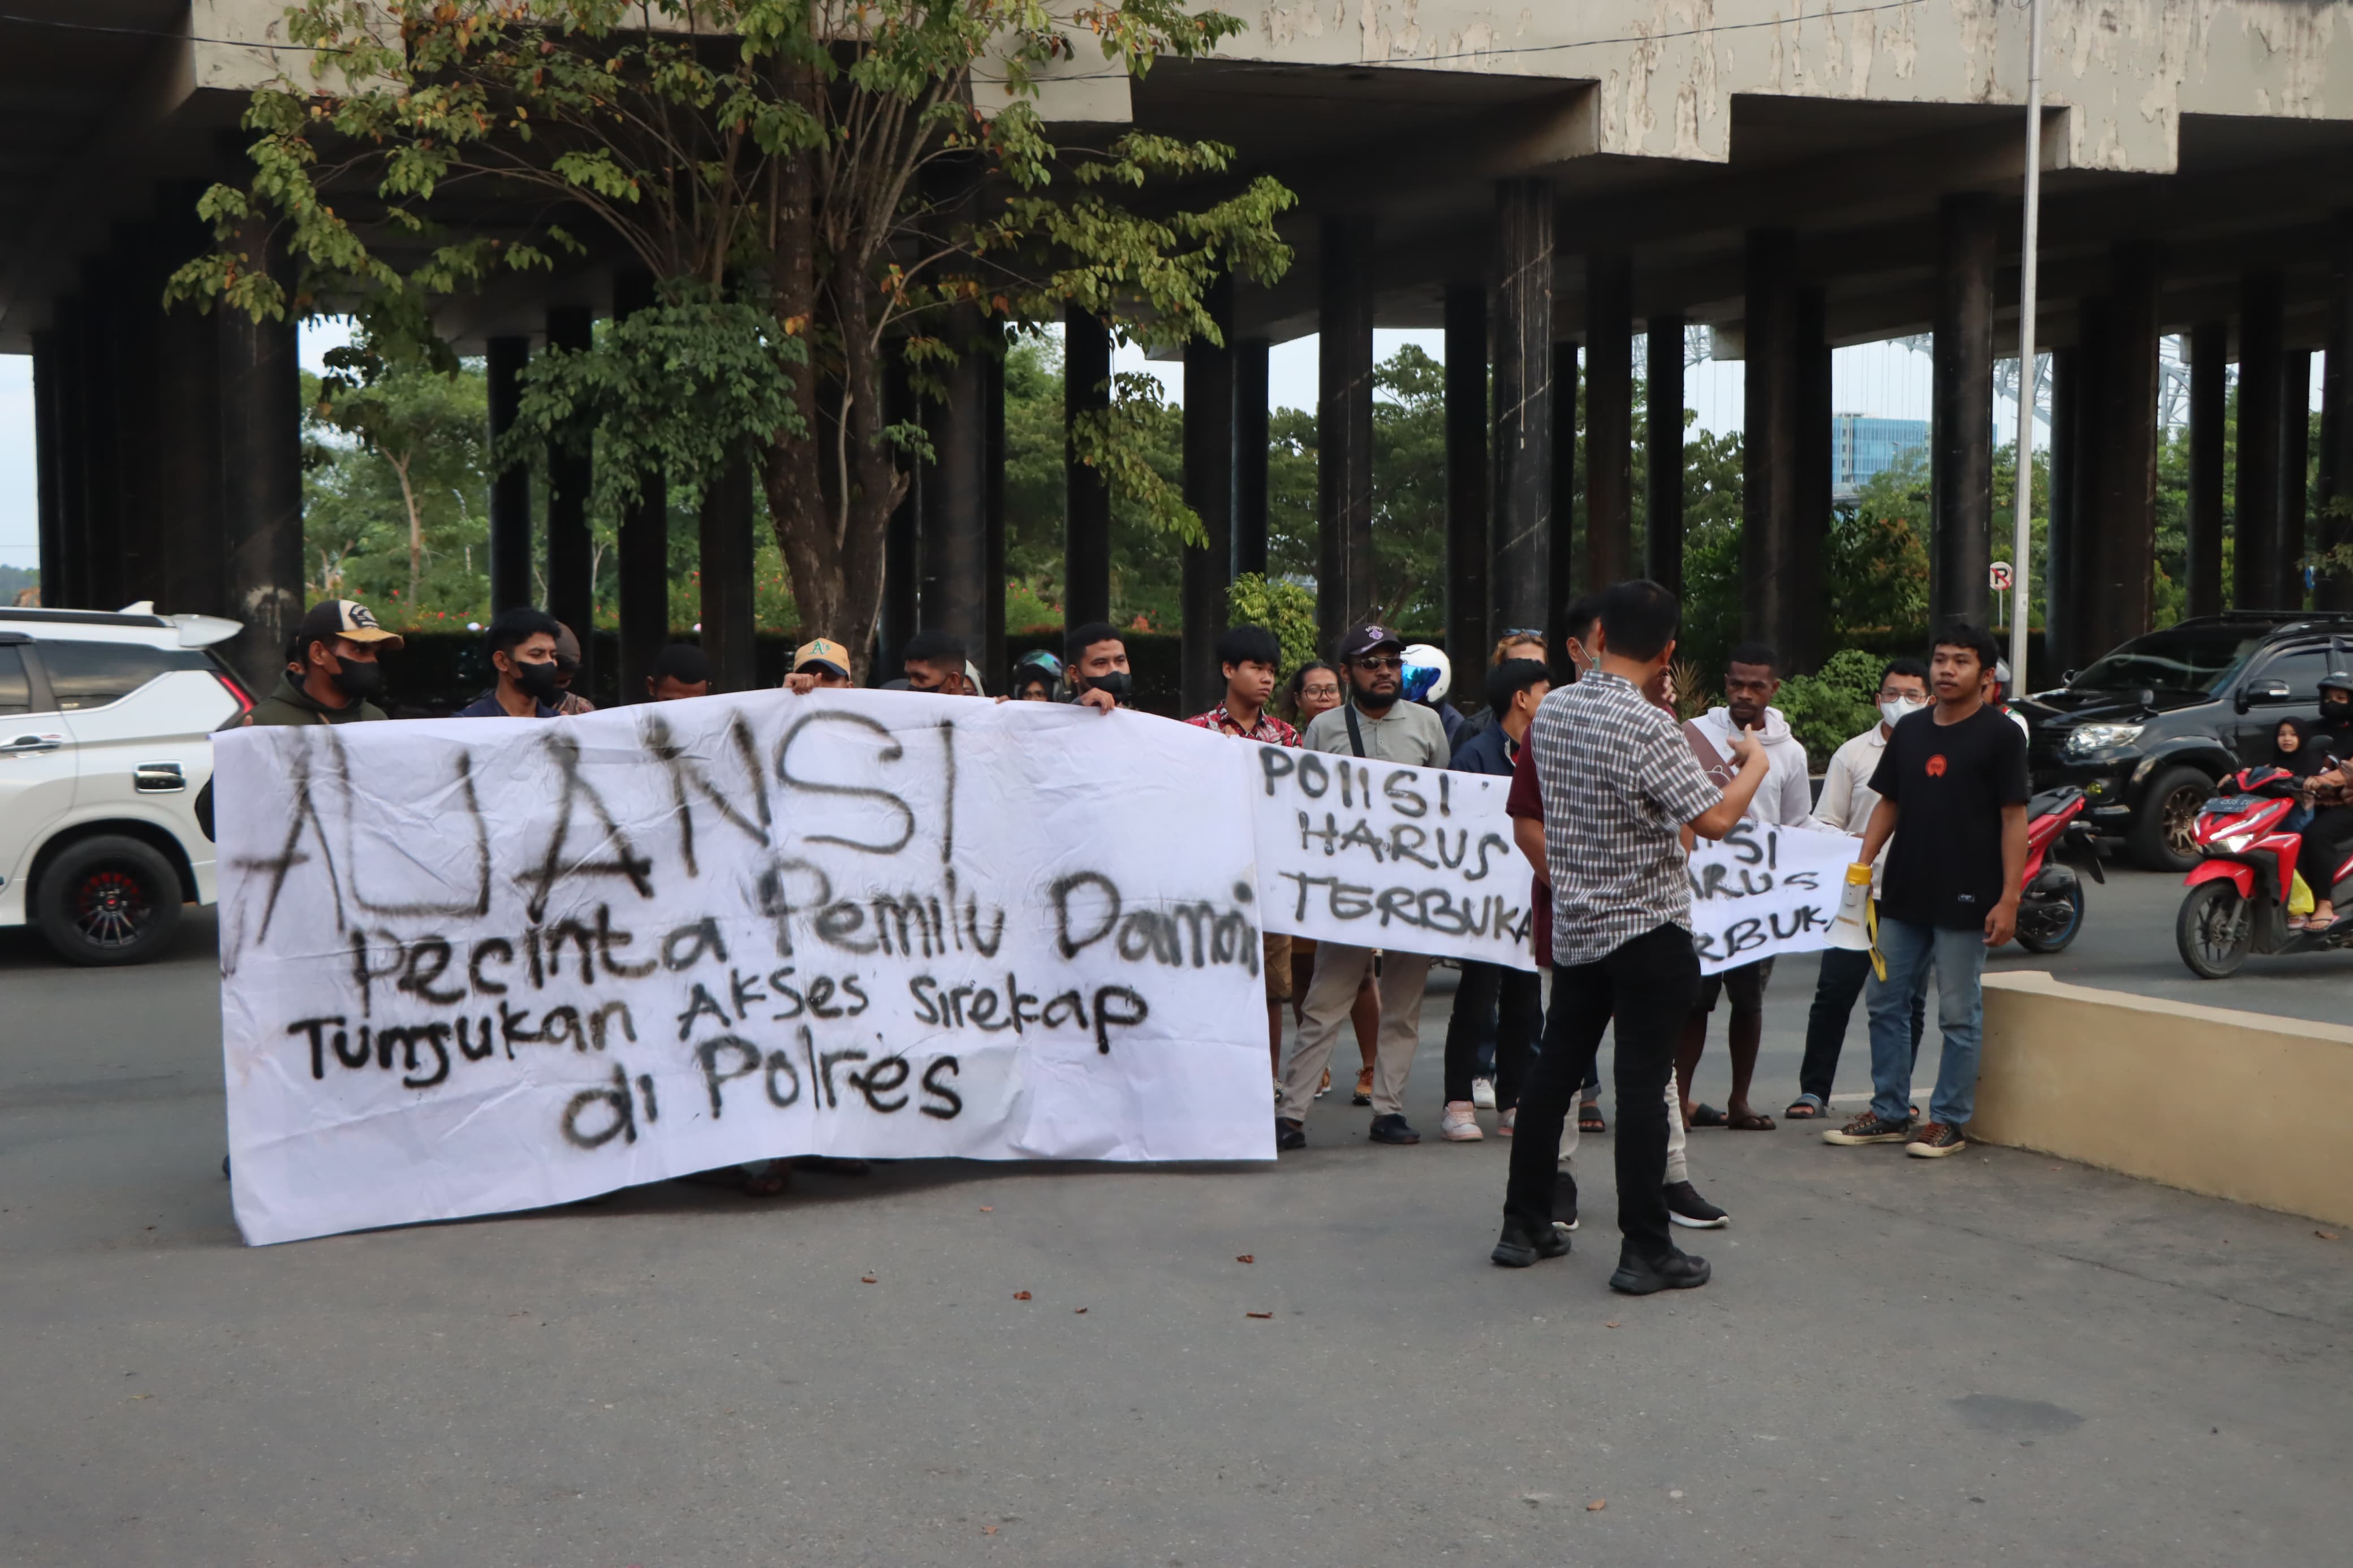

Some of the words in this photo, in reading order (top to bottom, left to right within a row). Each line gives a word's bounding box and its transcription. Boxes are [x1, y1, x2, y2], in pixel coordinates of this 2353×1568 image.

[1365, 625, 1383, 633] SCOUT
[1298, 810, 1510, 881] HARUS
[755, 856, 1005, 958] Pemilu
[1050, 871, 1260, 978] Damai
[1278, 870, 1535, 957] TERBUKA
[287, 1000, 638, 1088] Tunjukan
[909, 971, 1149, 1055] Sirekap
[561, 1061, 658, 1150] di
[695, 1023, 963, 1120] Polres
